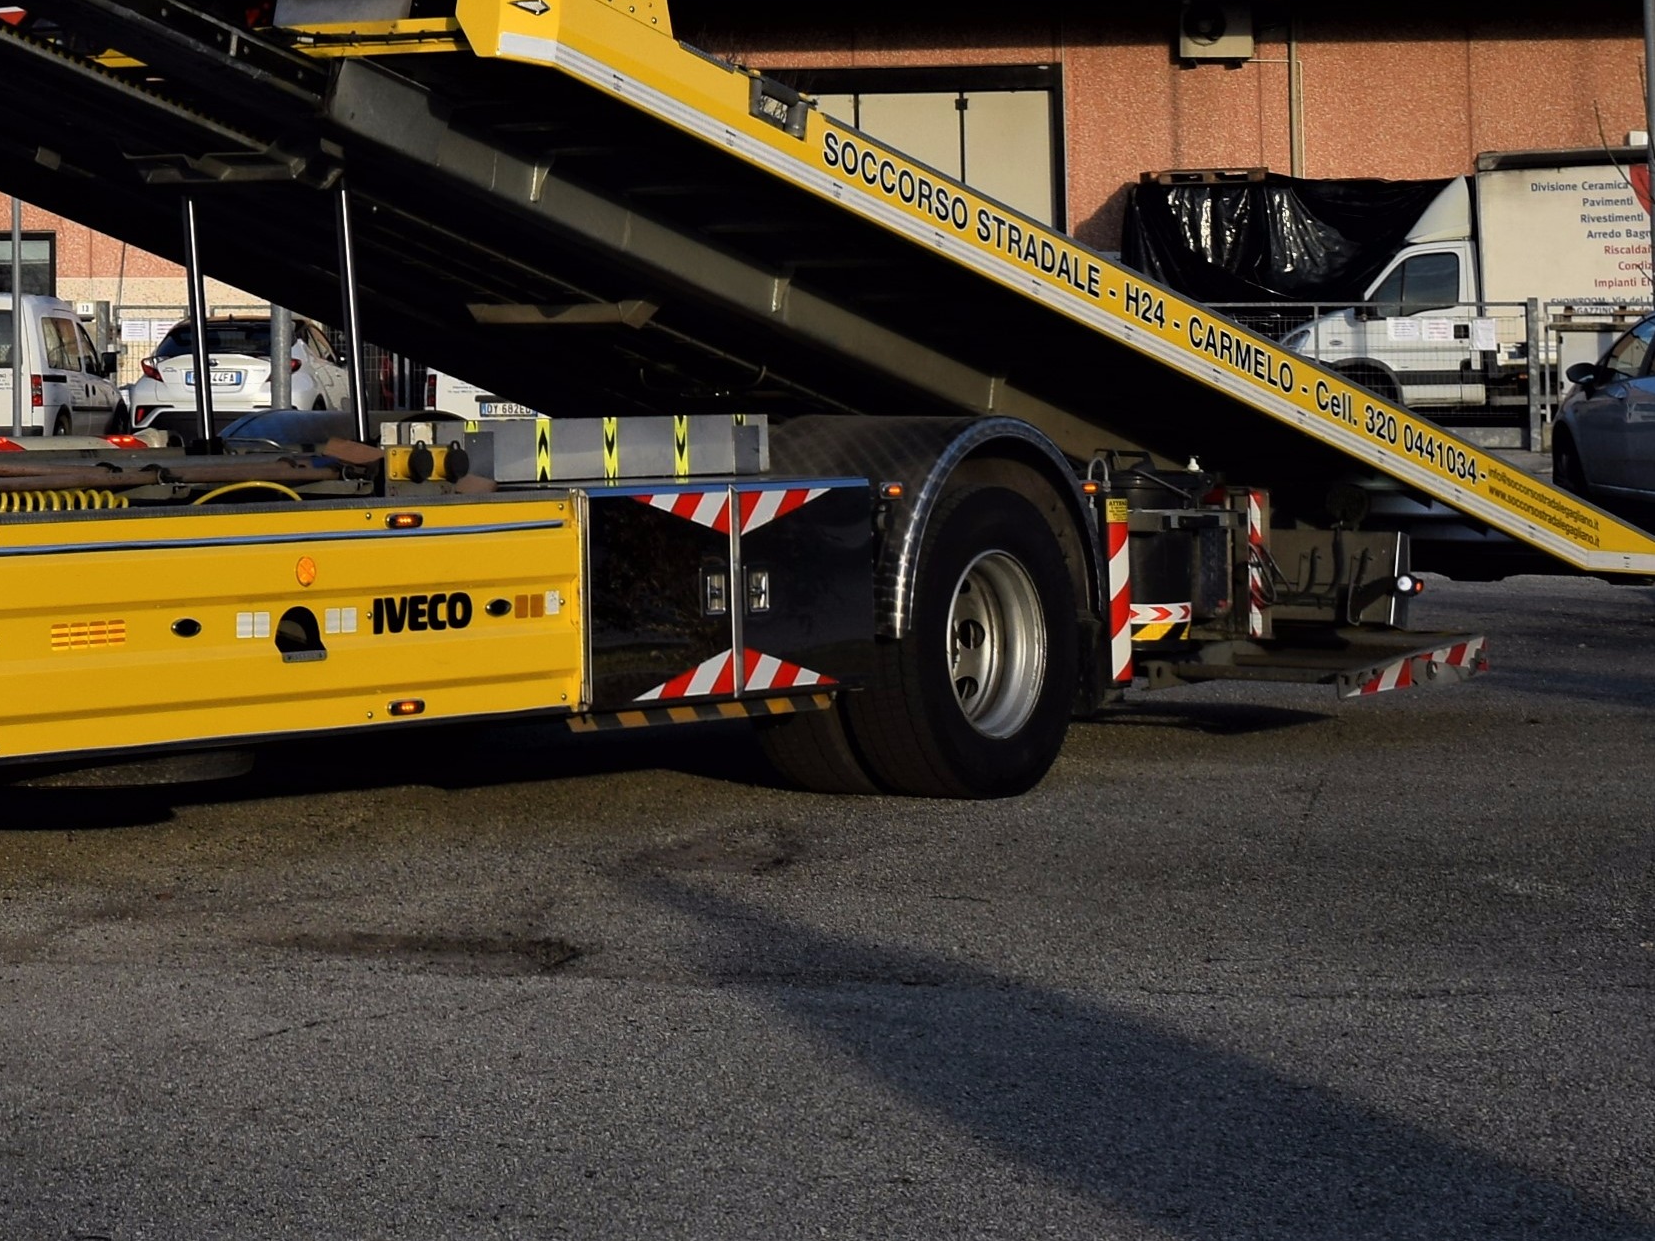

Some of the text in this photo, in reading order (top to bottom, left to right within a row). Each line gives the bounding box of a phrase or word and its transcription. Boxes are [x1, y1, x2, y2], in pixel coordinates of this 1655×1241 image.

[1530, 180, 1629, 192] Divisione Ceramica
[1582, 196, 1634, 207] Pavimenti
[1580, 212, 1644, 223] Rivestimenti
[1586, 229, 1622, 239] Arredo
[1594, 278, 1637, 290] Impianti
[823, 131, 968, 231] SOCCORSO
[976, 208, 1101, 299] STRADALE
[1125, 282, 1165, 329] H24
[1188, 316, 1294, 394] CARMELO
[1315, 380, 1357, 426] Cell.
[1365, 404, 1397, 444] 320
[1403, 423, 1477, 485] 0441034
[1487, 464, 1600, 531] info@soccorsostradalegagliano.it
[1487, 486, 1600, 547] www.soccorsostradalegagliano.it
[373, 591, 474, 636] IVECO
